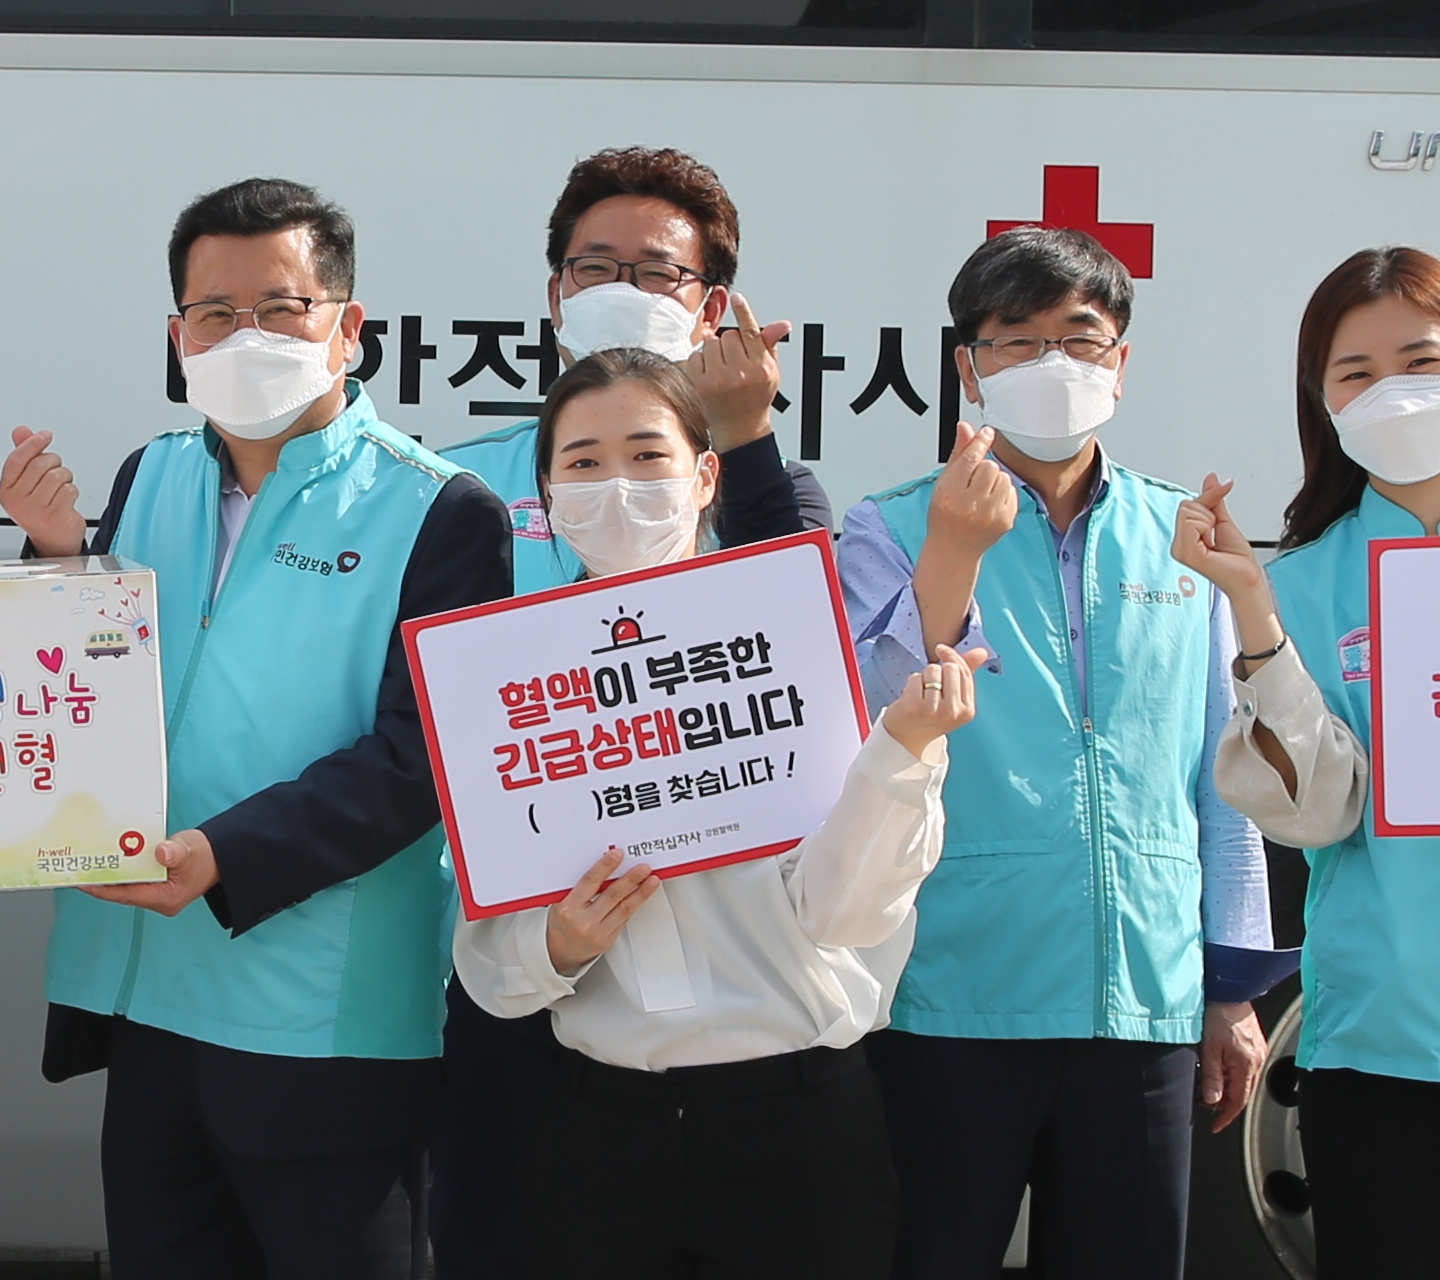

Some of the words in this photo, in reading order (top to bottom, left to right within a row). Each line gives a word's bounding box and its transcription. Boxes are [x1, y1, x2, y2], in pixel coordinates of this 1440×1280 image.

[272, 549, 333, 576] 민건강보험
[498, 662, 637, 731] 혈액이
[646, 632, 773, 696] 부족한
[493, 685, 805, 791] 긴급상태입니다
[627, 830, 702, 858] 대한적십자사
[37, 854, 119, 872] 국민건강보험
